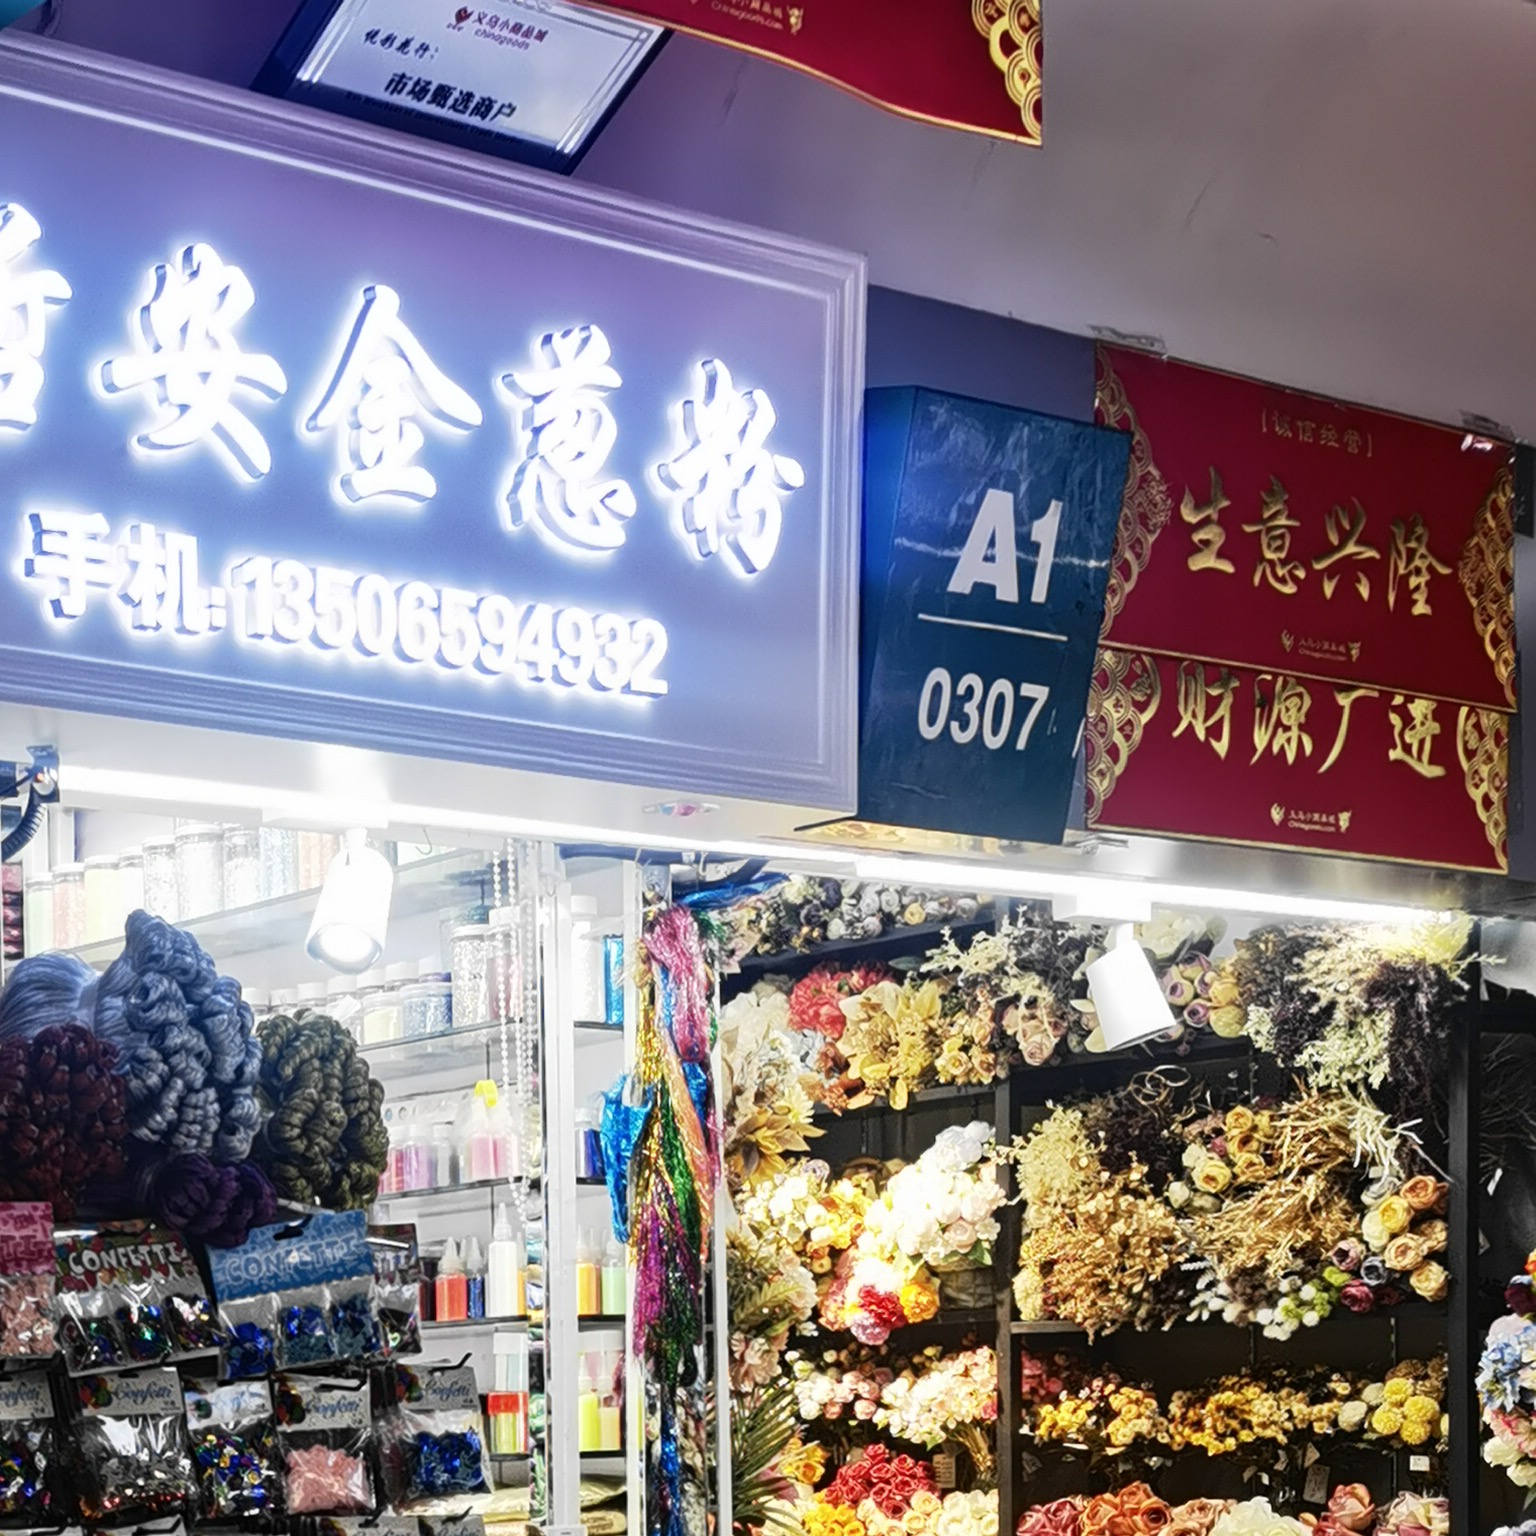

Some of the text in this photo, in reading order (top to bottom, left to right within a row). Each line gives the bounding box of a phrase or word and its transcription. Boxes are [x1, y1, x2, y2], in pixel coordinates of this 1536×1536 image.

[472, 10, 549, 43] 义乌小商品城
[474, 27, 530, 50] chinagoods
[384, 72, 517, 122] 市场甄选商户
[947, 488, 1064, 604] A1
[1179, 465, 1453, 616] 生意兴隆
[918, 667, 1050, 752] 0307
[1173, 660, 1446, 779] 财源广进
[68, 1244, 179, 1274] CONFETTI
[226, 1236, 362, 1280] CONFETTI
[111, 1381, 172, 1405] Confetti
[305, 1395, 360, 1420] Confetti
[424, 1383, 471, 1407] Confetti
